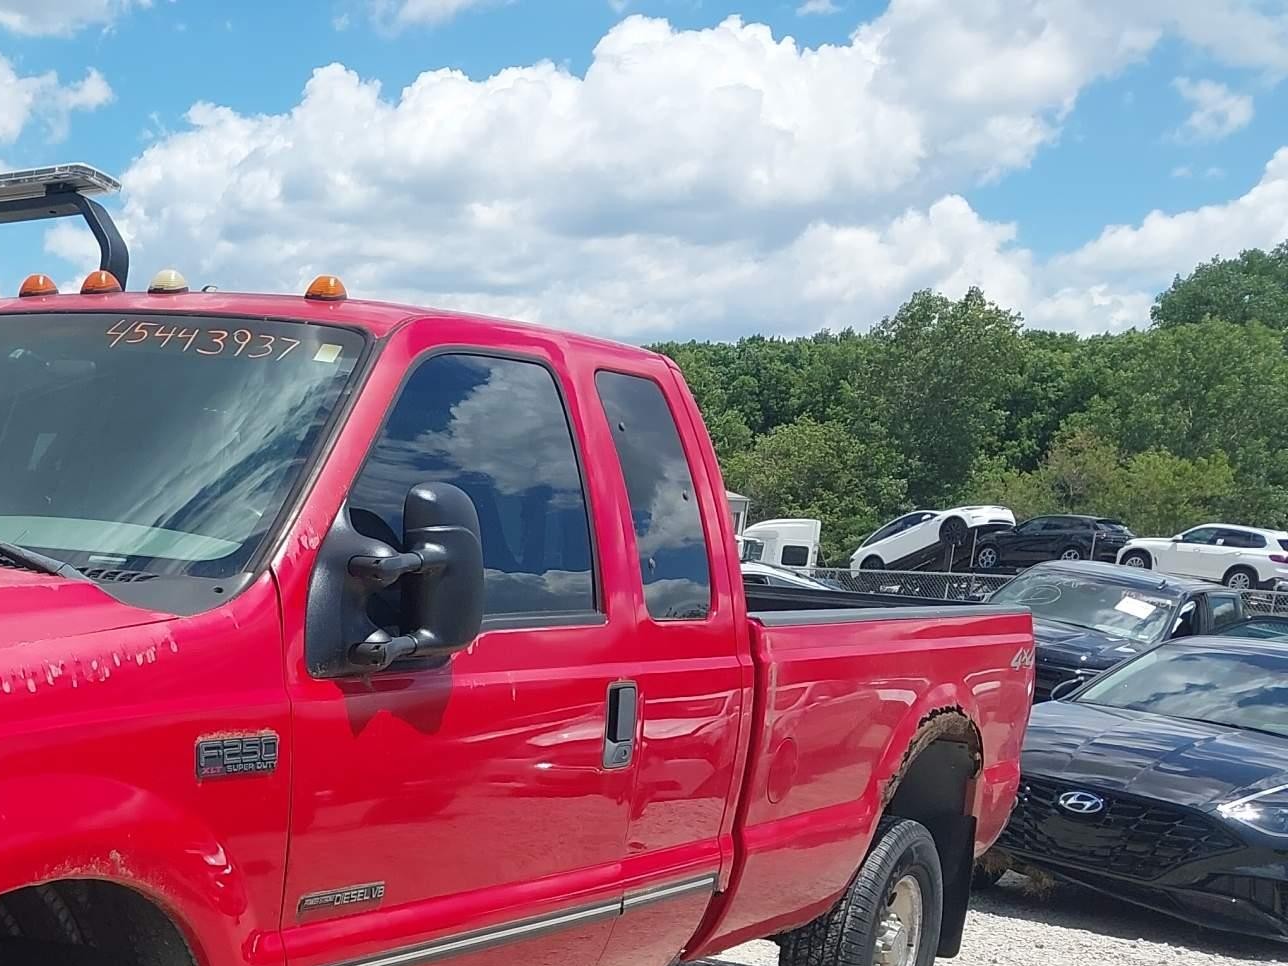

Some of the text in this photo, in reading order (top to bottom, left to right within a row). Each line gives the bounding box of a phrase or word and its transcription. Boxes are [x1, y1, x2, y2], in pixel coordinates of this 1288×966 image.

[106, 319, 300, 361] 45443937
[226, 763, 255, 773] SUPER
[256, 760, 278, 770] DUTY
[333, 887, 370, 906] DIESEL
